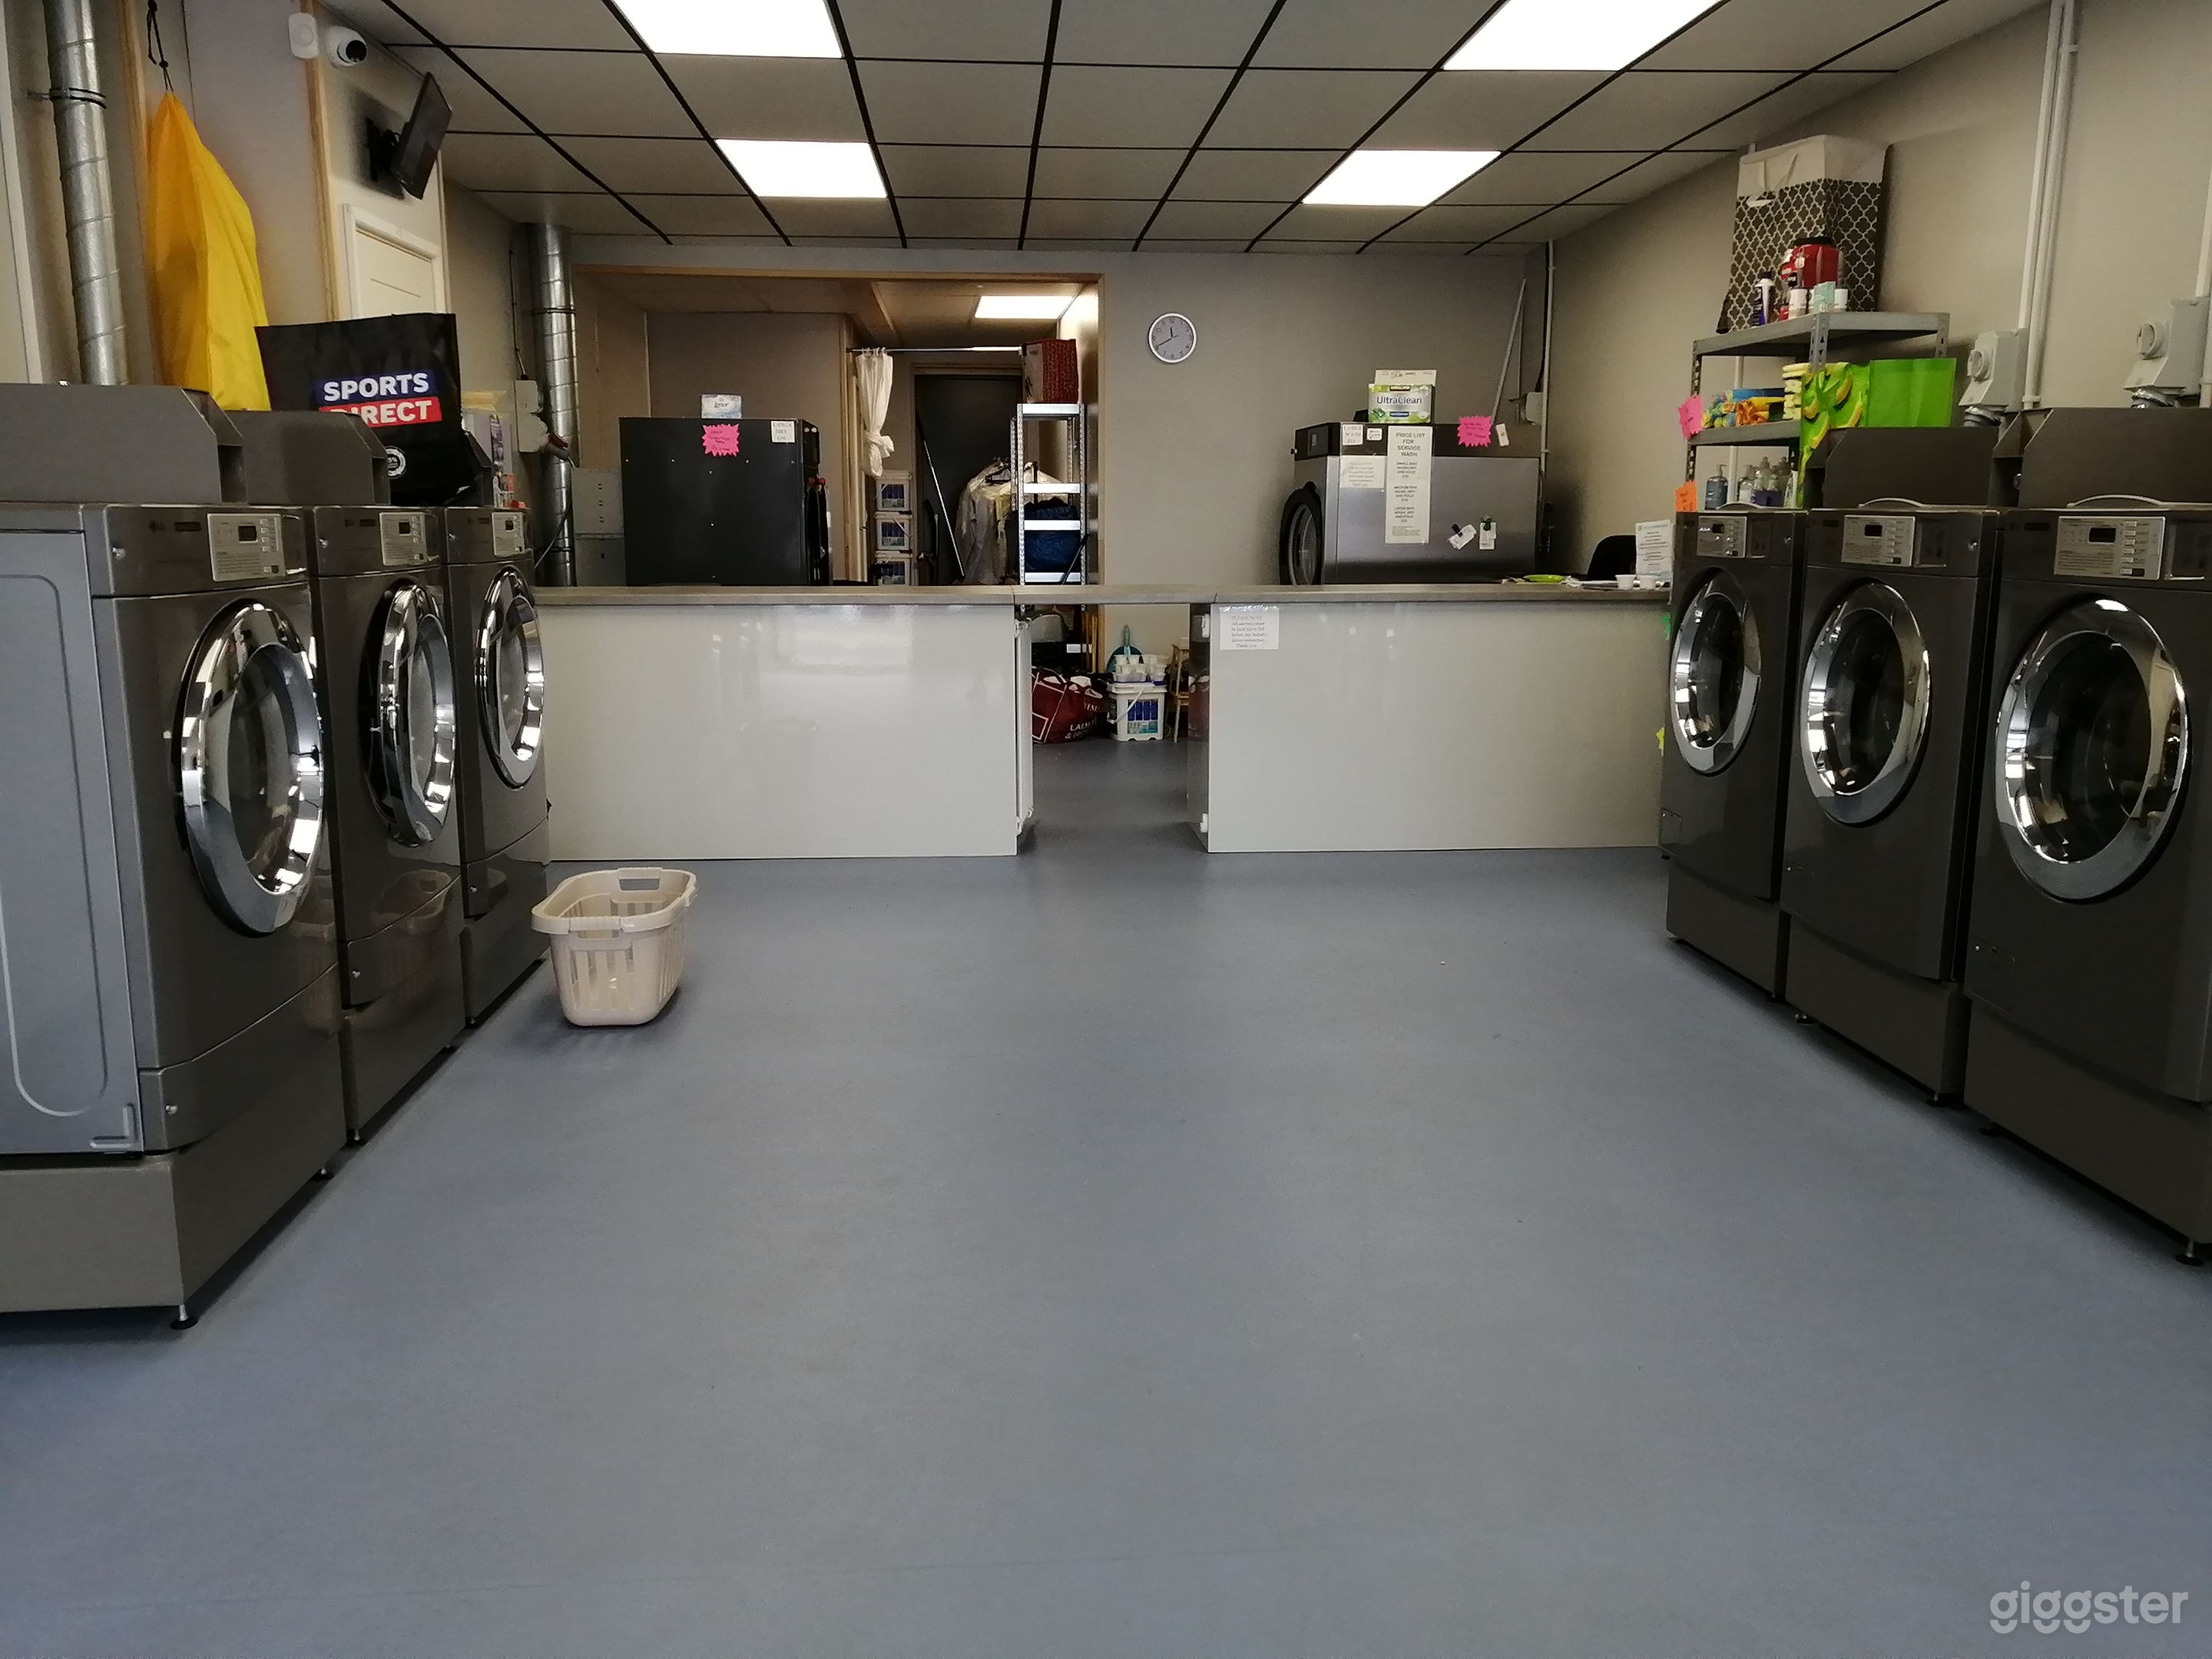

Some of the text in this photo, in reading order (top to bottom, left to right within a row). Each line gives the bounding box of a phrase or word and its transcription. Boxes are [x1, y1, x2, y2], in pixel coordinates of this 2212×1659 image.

[323, 373, 429, 402] SPORTS
[330, 400, 432, 424] RECT
[1376, 396, 1422, 404] UltraClean
